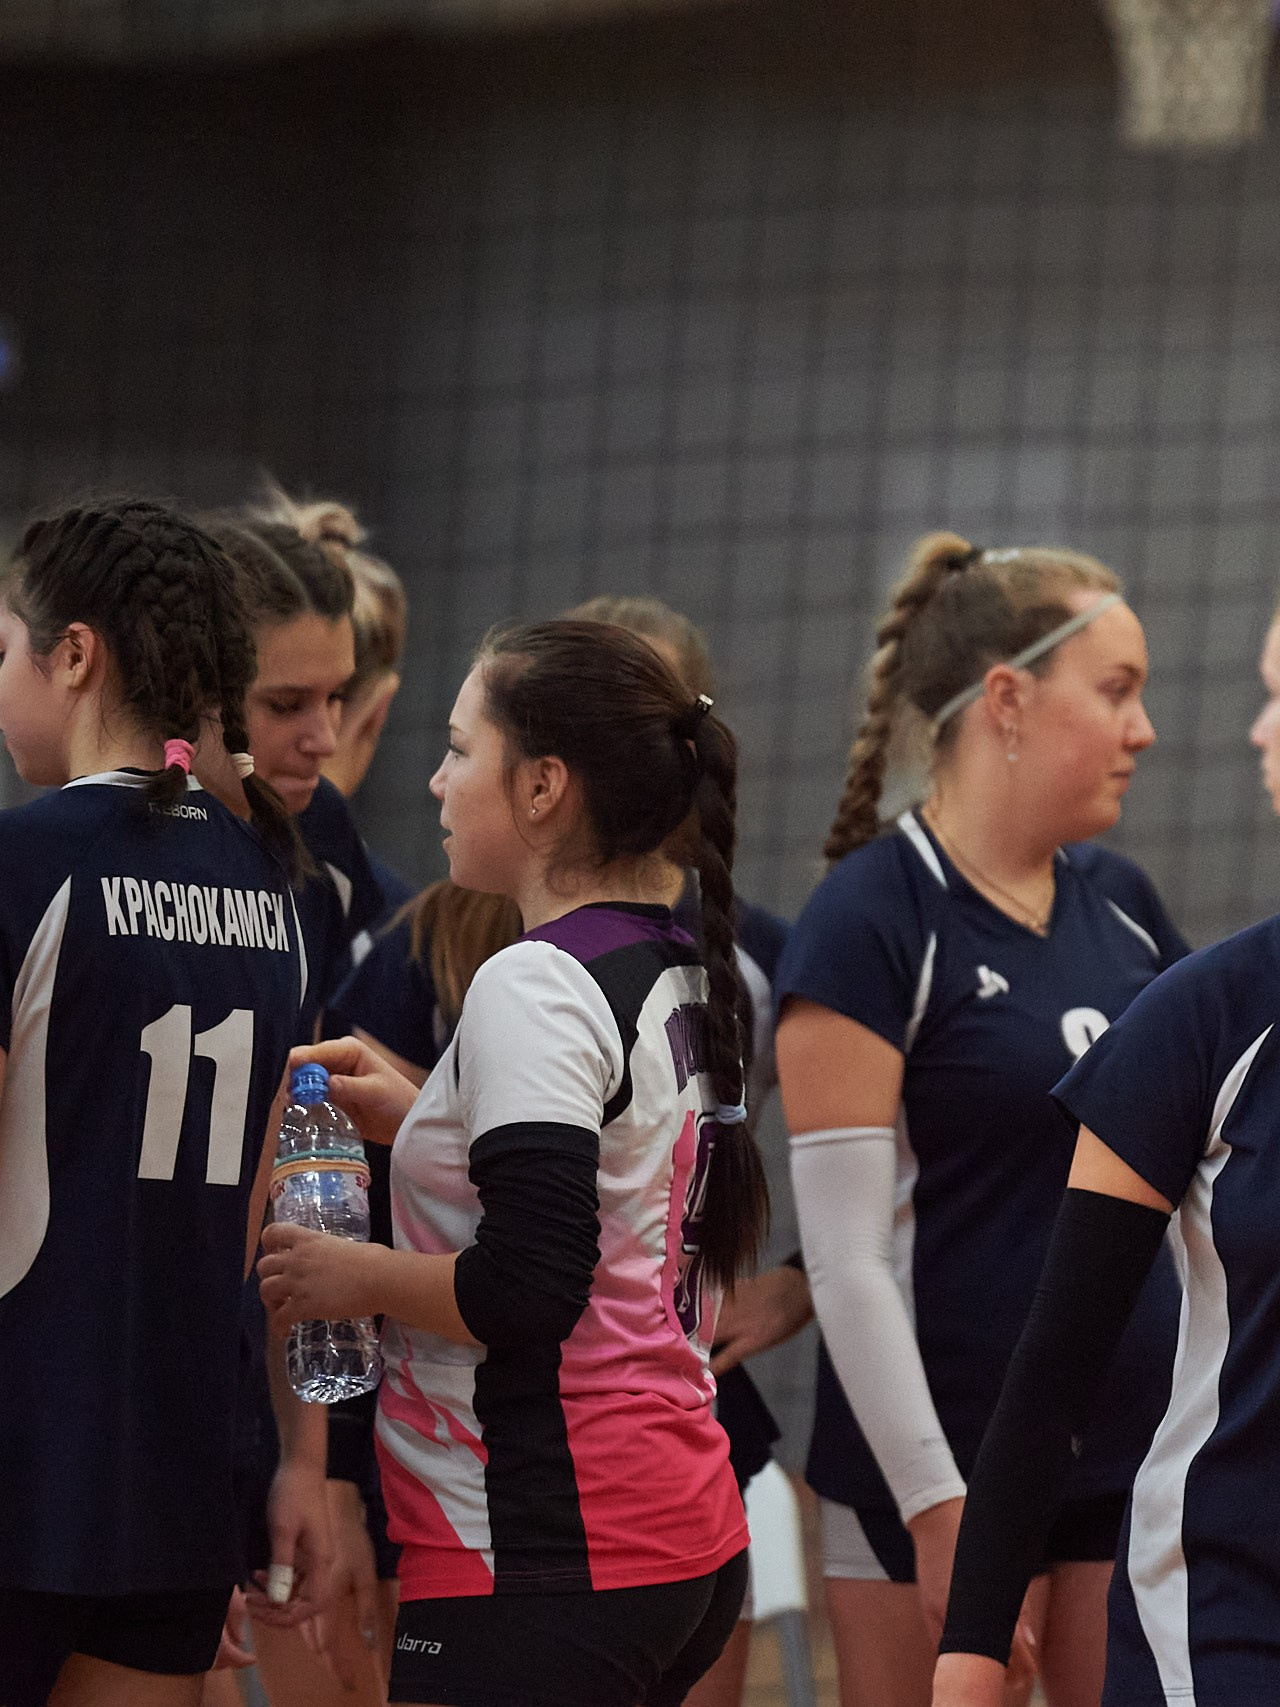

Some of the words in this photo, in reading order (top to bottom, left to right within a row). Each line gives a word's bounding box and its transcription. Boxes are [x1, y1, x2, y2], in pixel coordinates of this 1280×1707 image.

[148, 802, 208, 821] BORN
[100, 876, 291, 952] КРАСНОКАМСК
[136, 1003, 254, 1186] 11
